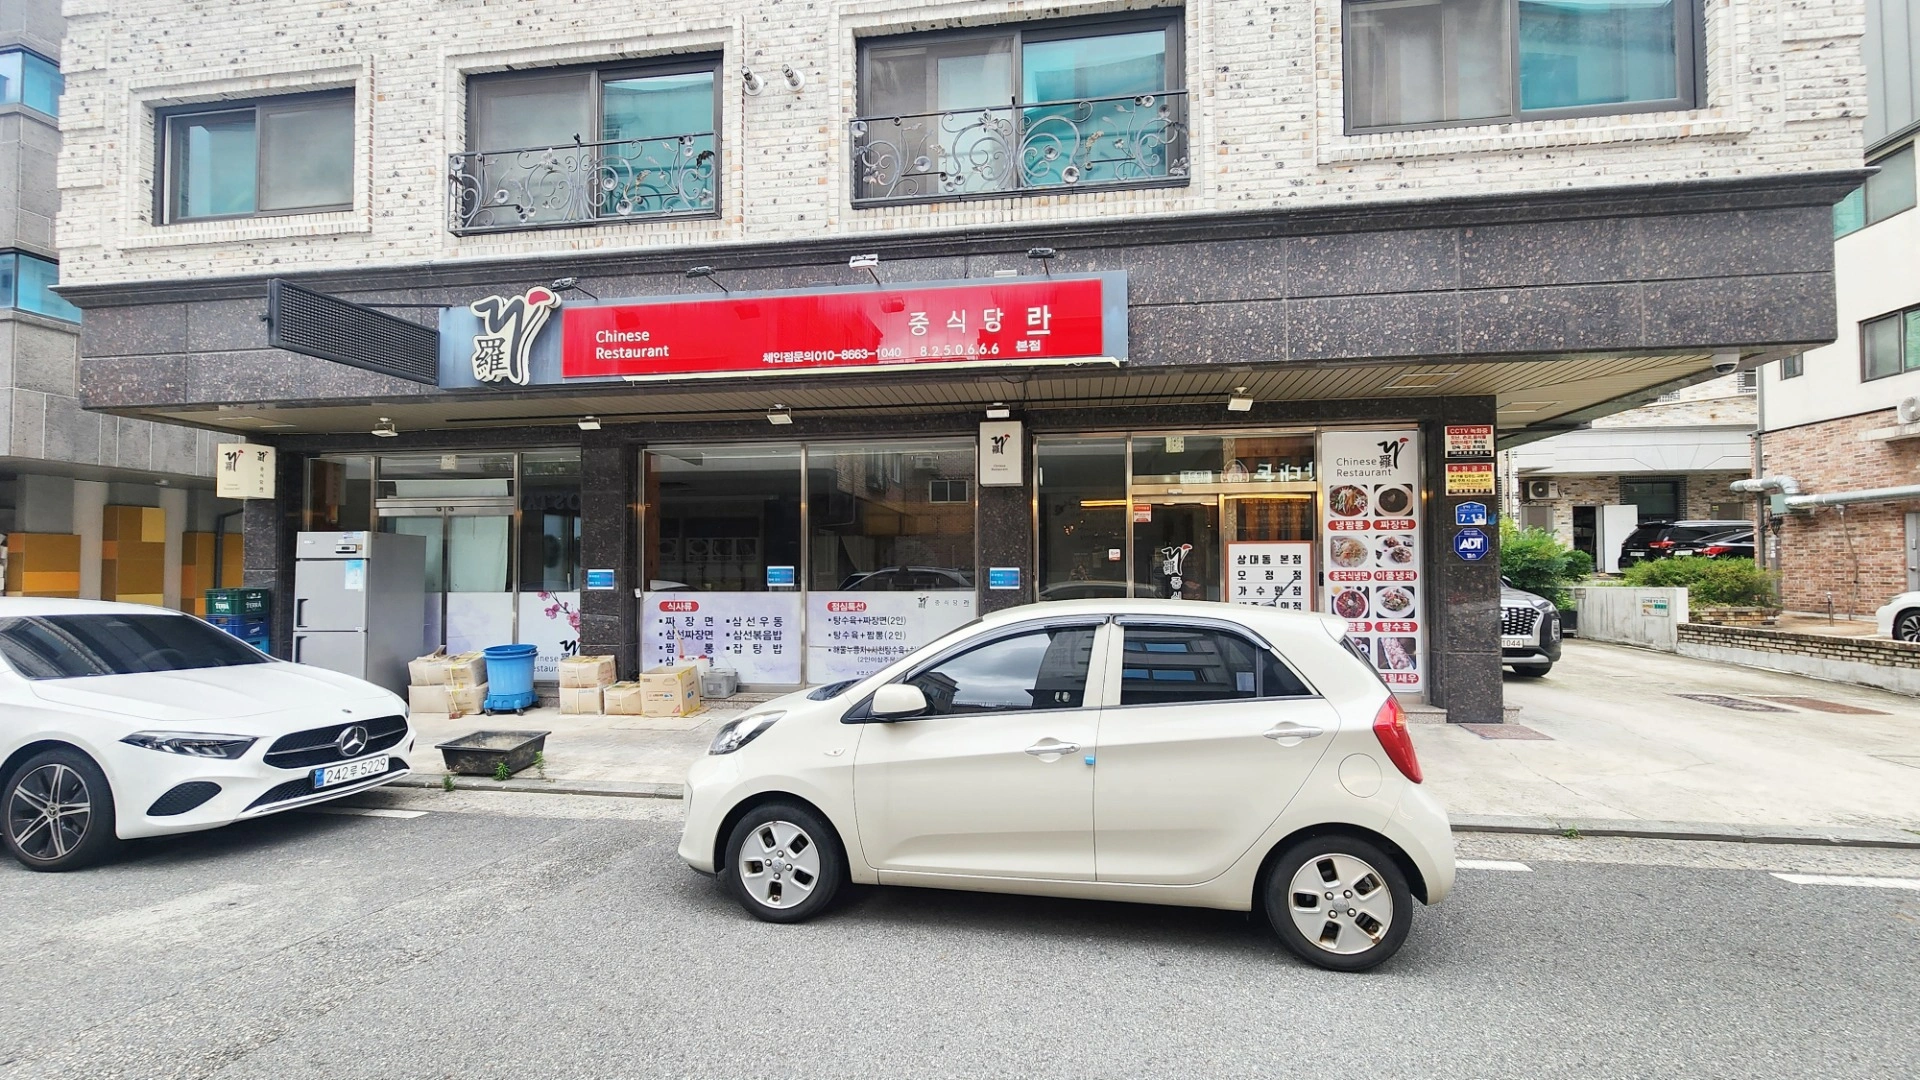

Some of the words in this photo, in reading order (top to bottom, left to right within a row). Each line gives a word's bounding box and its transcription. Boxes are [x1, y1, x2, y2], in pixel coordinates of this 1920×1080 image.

[596, 330, 649, 343] Chinese
[1016, 340, 1040, 352] 본점
[596, 345, 669, 360] Restaurant
[1336, 457, 1377, 467] Chinese
[1336, 468, 1392, 477] Restaurant
[1381, 520, 1409, 530] 짜장면
[1460, 538, 1483, 549] ADT
[1238, 555, 1271, 565] 상대동
[1280, 555, 1301, 565] 본점
[667, 602, 692, 611] 식사류
[831, 602, 865, 612] 점심특선
[1382, 622, 1411, 632] 탕수육
[732, 630, 783, 641] 삼선볶음밥
[361, 758, 387, 775] 5229
